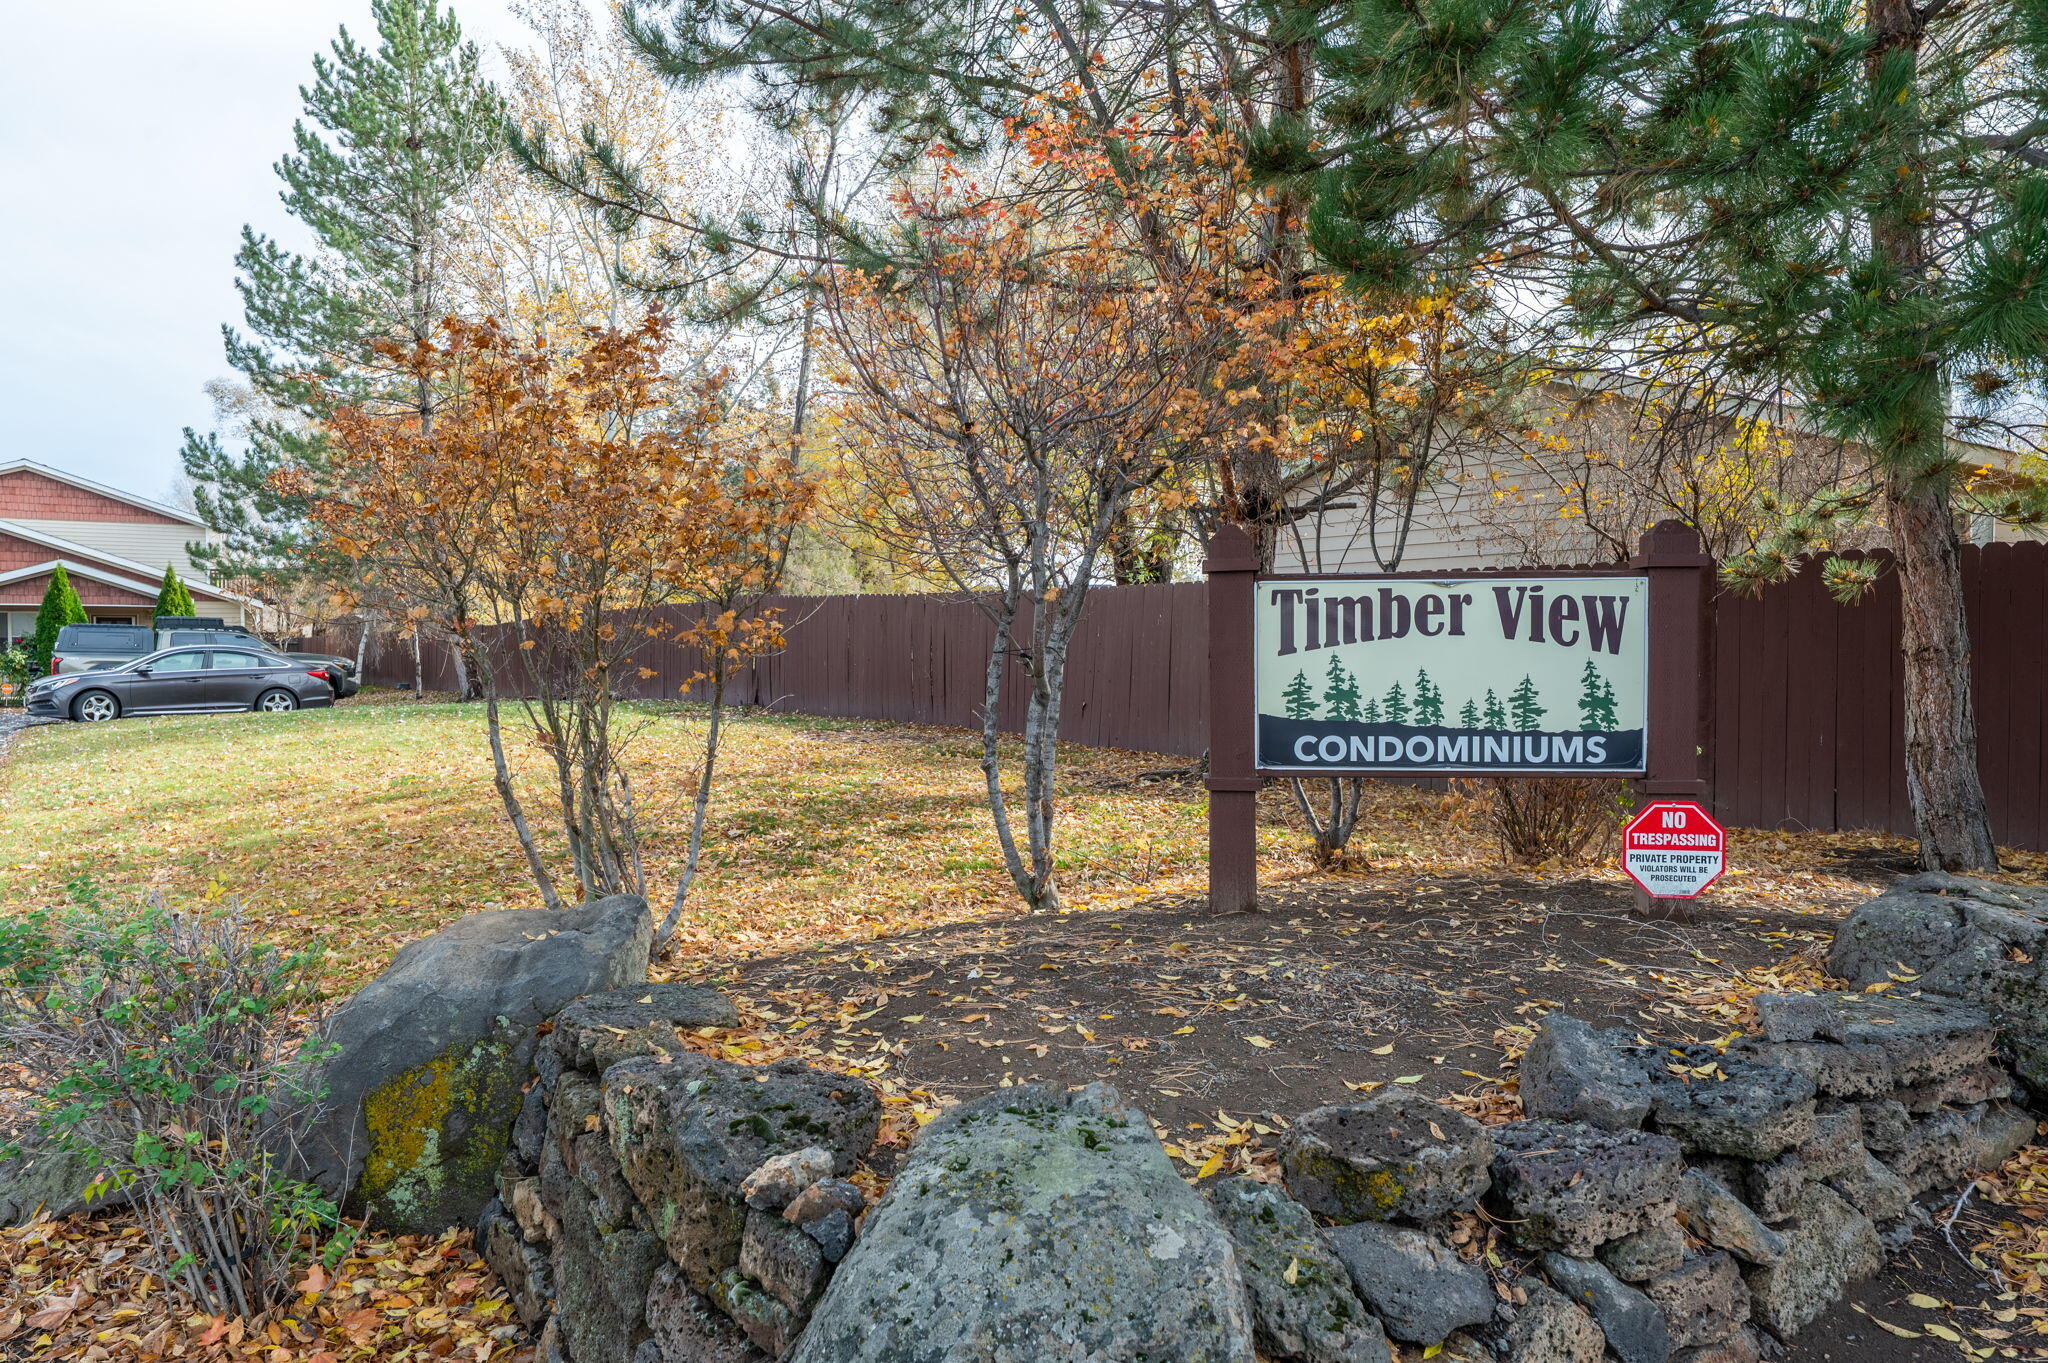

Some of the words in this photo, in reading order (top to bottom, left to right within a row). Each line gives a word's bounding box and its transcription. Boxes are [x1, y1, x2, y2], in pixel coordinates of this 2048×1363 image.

[1271, 587, 1473, 657] Timber
[1492, 585, 1630, 656] View
[1293, 734, 1607, 764] CONDOMINIUMS
[1661, 811, 1687, 829] NO
[1631, 832, 1717, 847] TRESPASSING
[1629, 853, 1667, 863] PRIVATE
[1670, 854, 1719, 864] PROPERTY
[1639, 864, 1678, 873] VIOLATORS
[1679, 865, 1697, 874] WILL
[1698, 866, 1708, 874] BE
[1650, 874, 1697, 883] PROSECUTED
